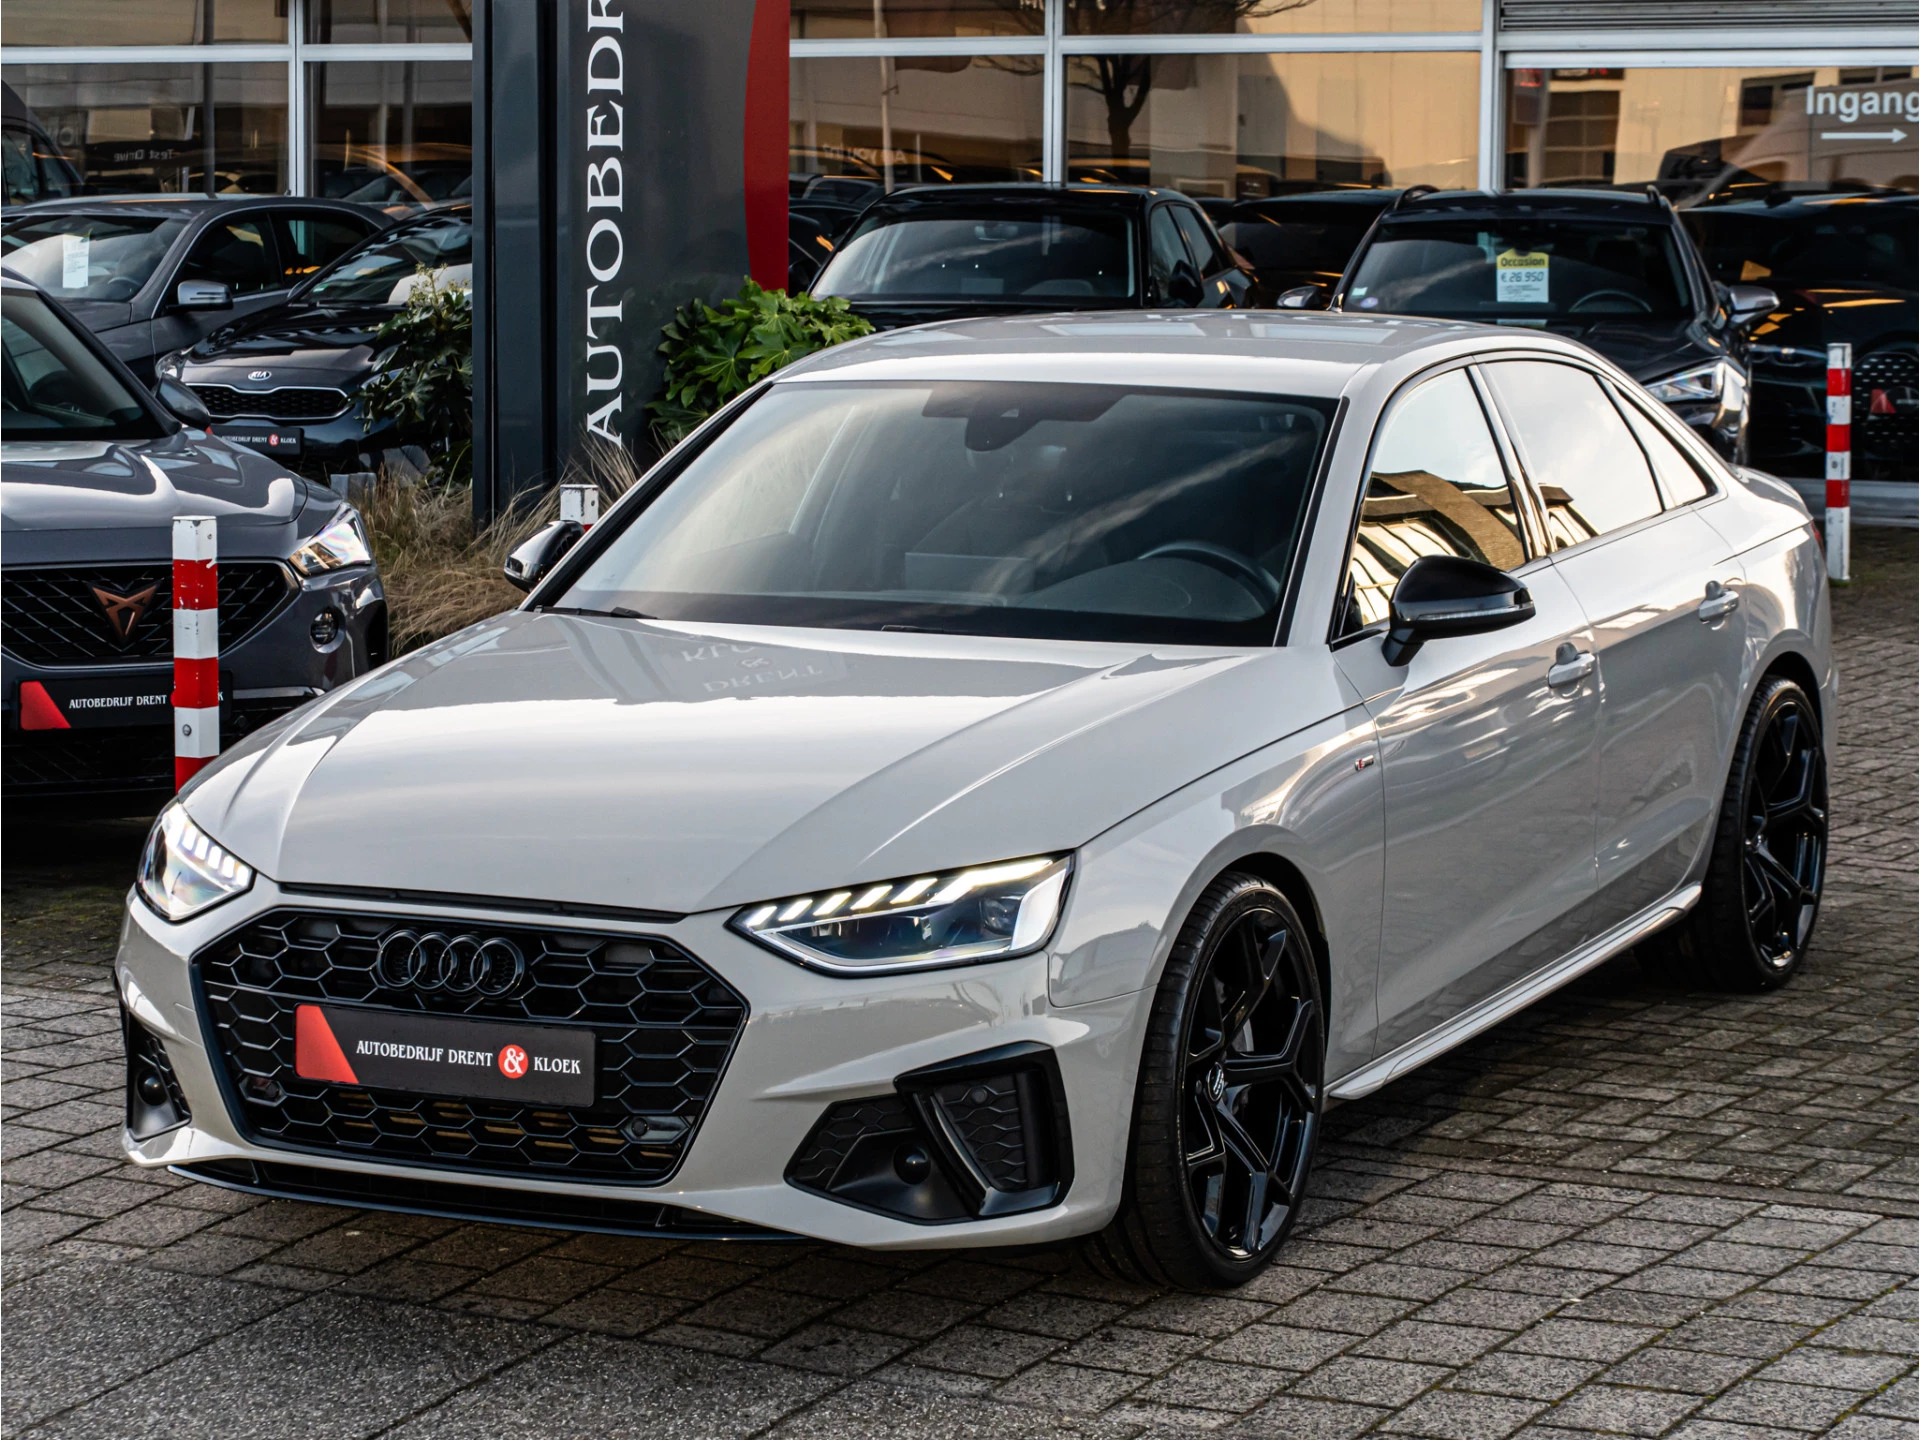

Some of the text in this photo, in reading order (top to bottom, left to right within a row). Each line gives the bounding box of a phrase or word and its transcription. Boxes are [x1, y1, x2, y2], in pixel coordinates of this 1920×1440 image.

[1806, 85, 1919, 123] Ingang
[1500, 257, 1545, 267] Occasion
[69, 694, 167, 709] AUTOBEDRIJF DRENT
[356, 1040, 581, 1074] AUTOBEDRIJF DRENT & KLOEK
